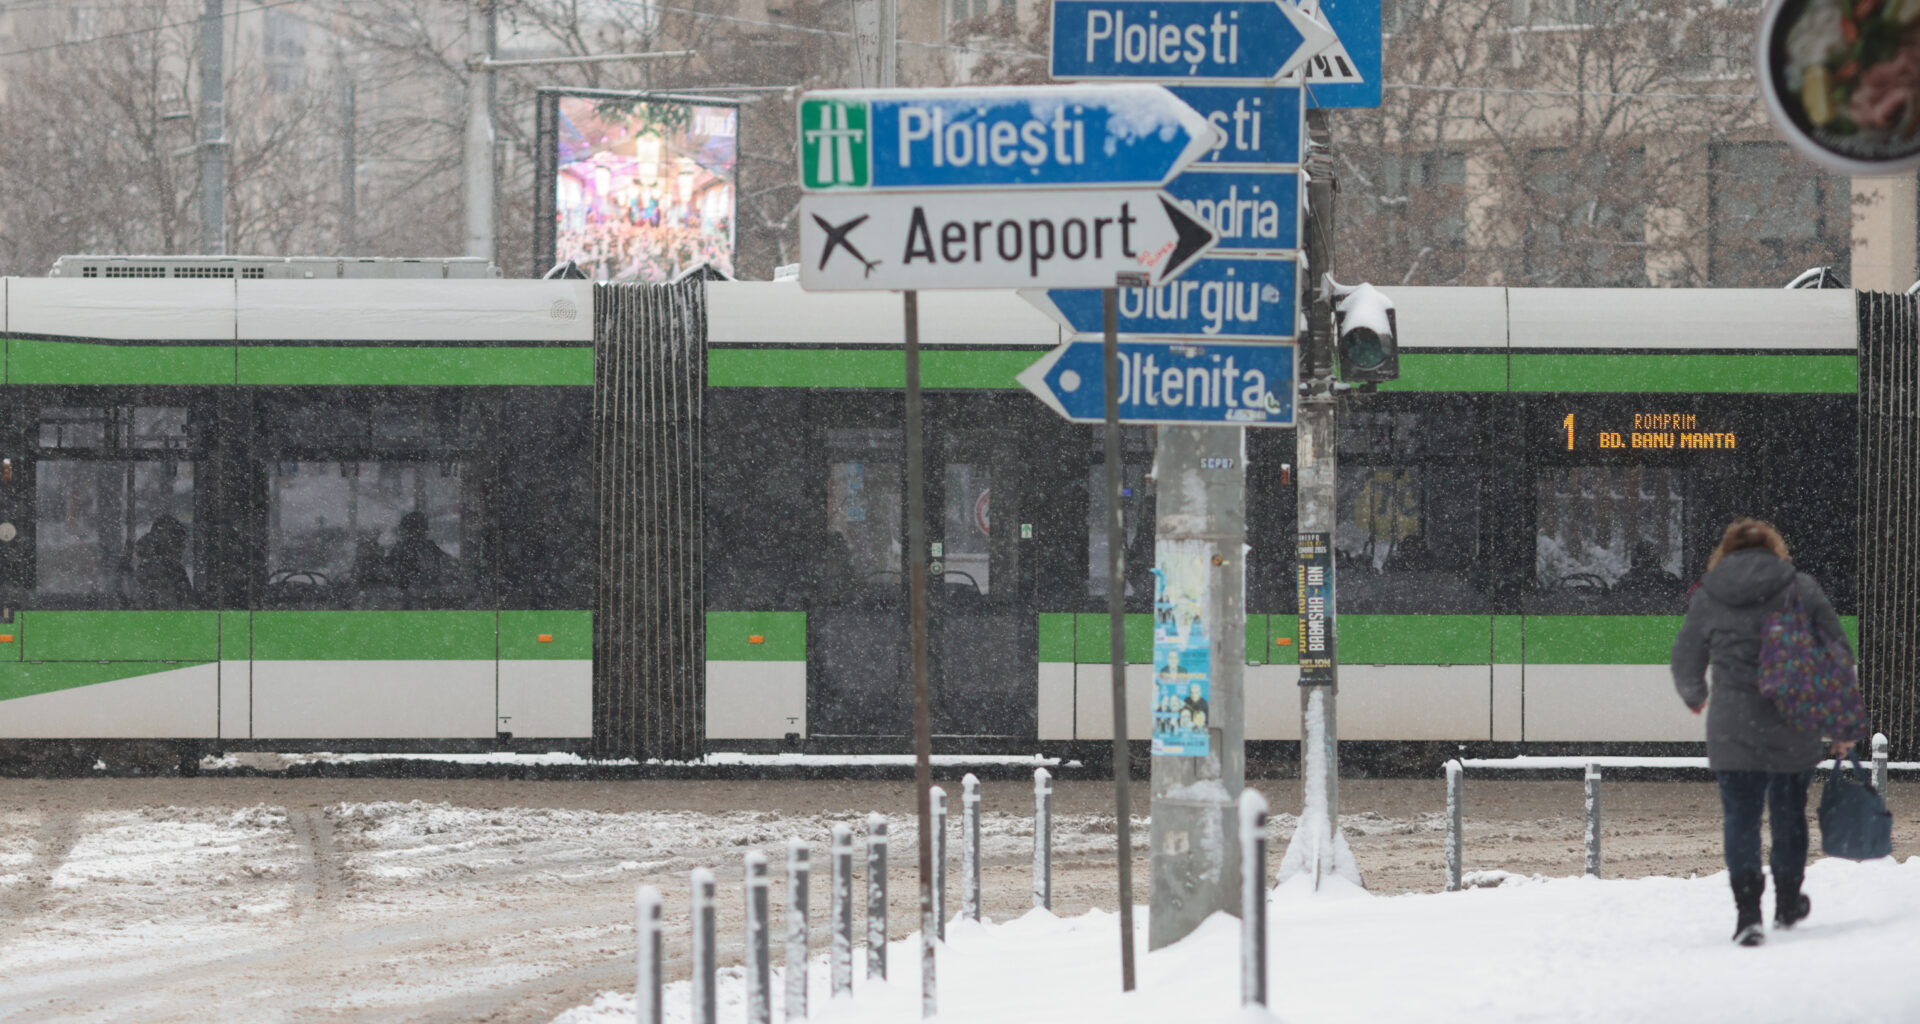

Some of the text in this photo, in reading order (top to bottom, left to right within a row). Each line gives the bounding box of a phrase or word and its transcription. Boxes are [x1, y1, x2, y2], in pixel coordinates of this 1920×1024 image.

[1086, 9, 1238, 75] Ploiești
[899, 105, 1085, 176] Ploiești
[1207, 97, 1261, 161] ști
[903, 201, 1137, 278] Aeroport
[1118, 267, 1259, 334] Giurgiu
[1563, 413, 1574, 450] 1
[1600, 433, 1735, 449] BD. BANU MANTA
[1634, 413, 1696, 430] ROMPRIM
[1307, 566, 1324, 586] IAN
[1308, 597, 1325, 651] BABASHA
